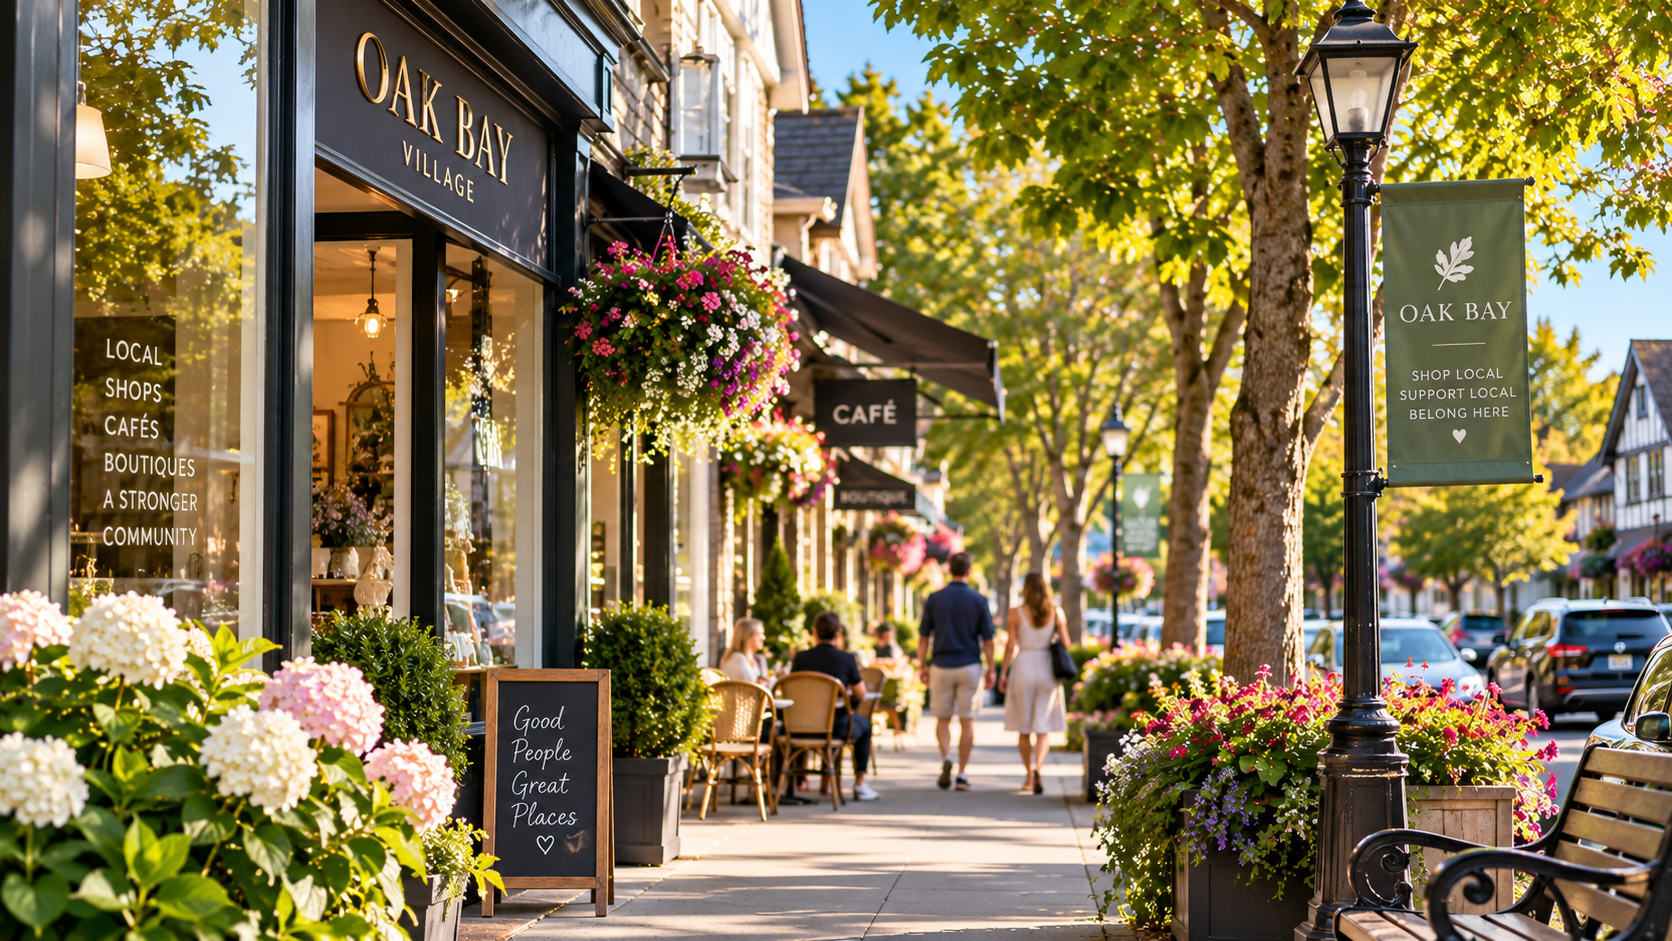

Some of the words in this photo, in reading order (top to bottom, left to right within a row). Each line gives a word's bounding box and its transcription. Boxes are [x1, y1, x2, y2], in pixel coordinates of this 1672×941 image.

[354, 31, 444, 145] OAK
[455, 94, 515, 187] BAY
[402, 139, 476, 204] VILLAGE
[1399, 302, 1455, 323] OAK
[1464, 301, 1512, 321] BAY
[106, 338, 163, 367] LOCAL
[1411, 369, 1451, 382] SHOP
[1456, 367, 1504, 380] LOCAL
[105, 377, 162, 404] SHOPS
[1399, 388, 1465, 401] SUPPORT
[1470, 386, 1517, 399] LOCAL
[832, 399, 897, 425] CAFÉ
[1409, 407, 1467, 420] BELONG
[1473, 405, 1509, 418] HERE
[104, 412, 159, 440] CAFÉS
[104, 452, 196, 478] BOUTIQUES
[103, 489, 114, 509] A
[119, 489, 198, 512] STRONGER
[102, 525, 198, 547] COMMUNITY
[513, 704, 565, 737] Good
[511, 737, 573, 771] People
[511, 770, 570, 800] Great
[510, 801, 578, 828] Places
